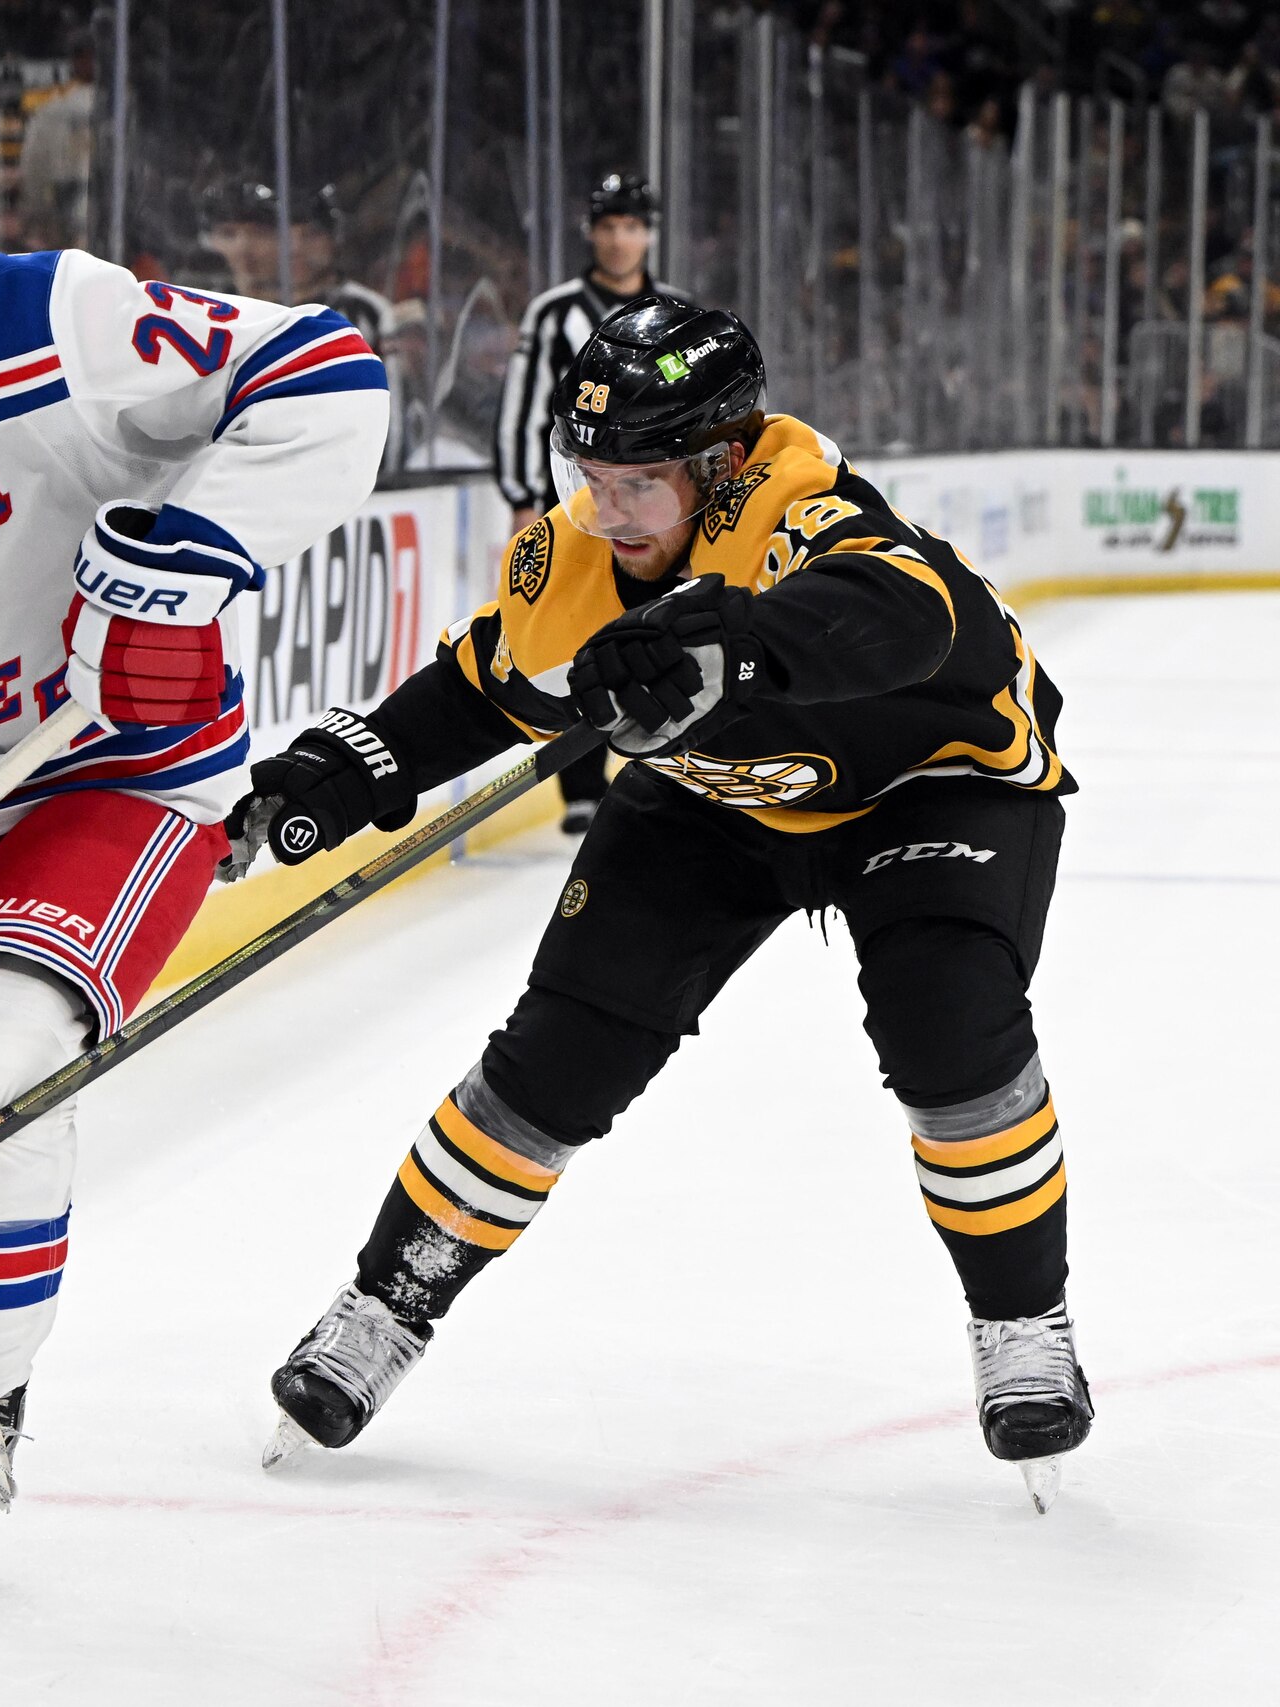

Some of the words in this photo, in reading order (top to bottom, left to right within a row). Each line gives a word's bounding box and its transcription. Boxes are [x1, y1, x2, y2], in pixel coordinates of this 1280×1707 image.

[131, 280, 239, 377] 23
[685, 337, 720, 365] Bank
[576, 381, 610, 414] 28
[738, 661, 756, 681] 28
[862, 842, 998, 875] CCM
